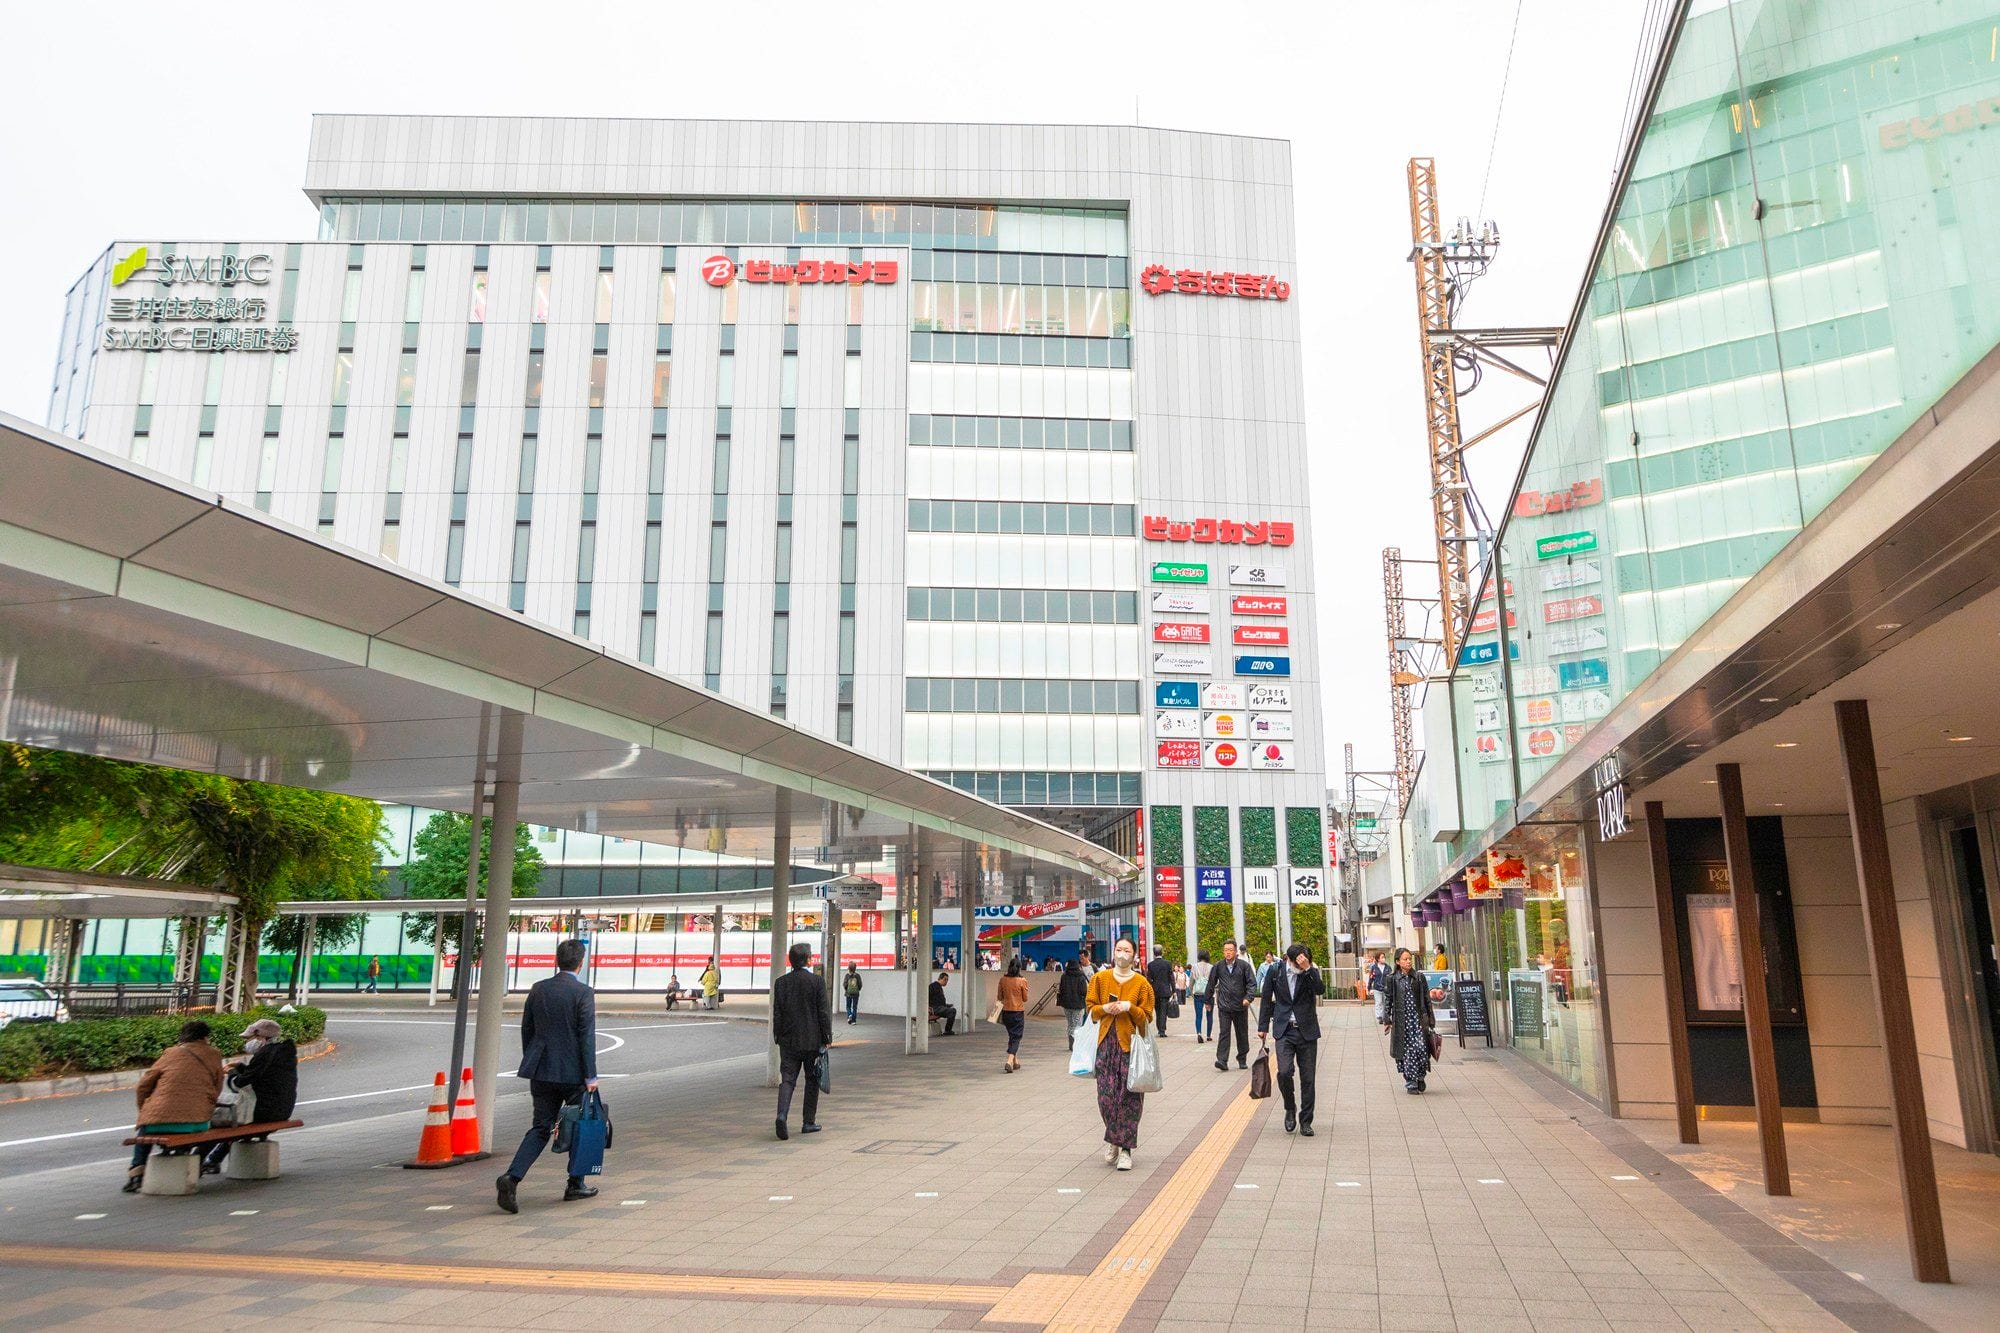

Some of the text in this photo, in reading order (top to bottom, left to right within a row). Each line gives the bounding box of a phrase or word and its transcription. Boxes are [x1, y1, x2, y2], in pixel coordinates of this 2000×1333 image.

[157, 254, 272, 284] SMBC
[746, 260, 898, 283] ビックカメラ
[1175, 269, 1291, 299] ちばぎん
[107, 298, 265, 320] 三井住友銀行
[104, 327, 298, 350] SMBC日興証券
[1143, 515, 1295, 547] ビックカメラ
[1249, 568, 1266, 577] くら
[1253, 697, 1288, 706] ルノアール
[1294, 875, 1320, 889] くら
[1295, 889, 1320, 897] KURA
